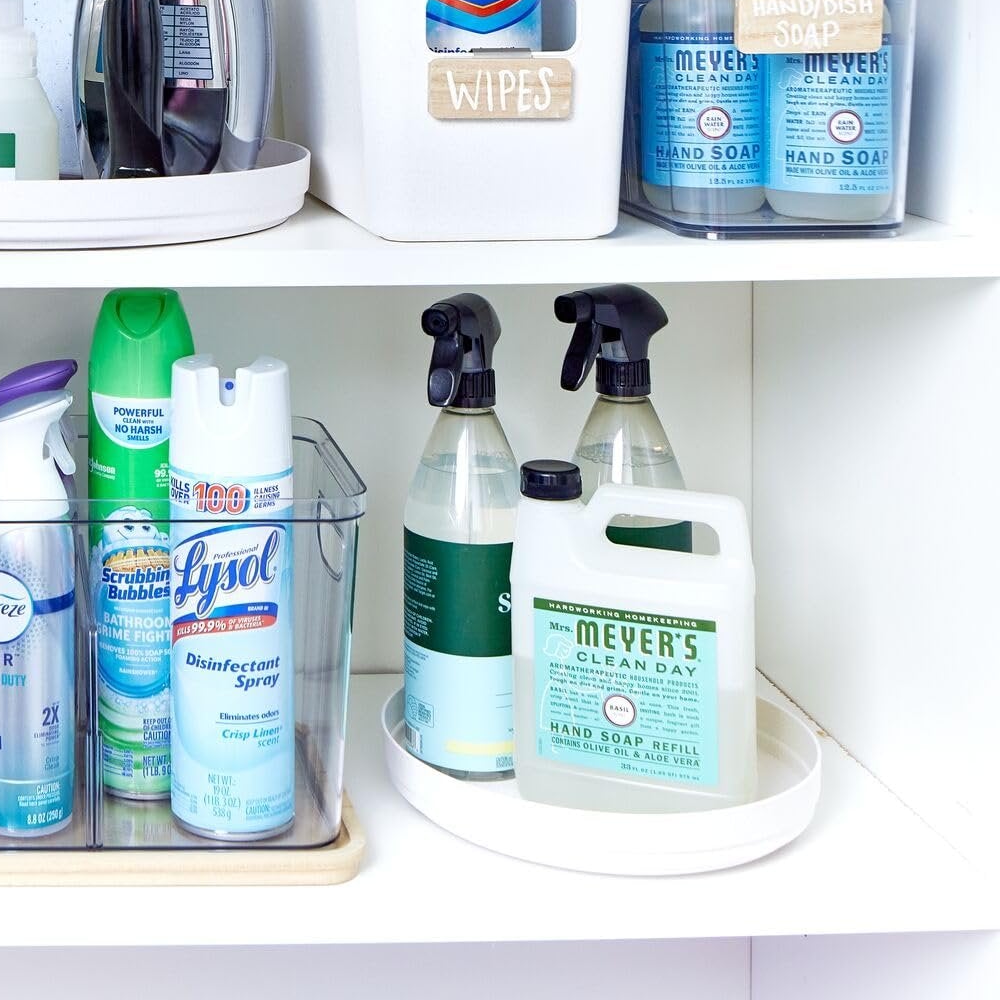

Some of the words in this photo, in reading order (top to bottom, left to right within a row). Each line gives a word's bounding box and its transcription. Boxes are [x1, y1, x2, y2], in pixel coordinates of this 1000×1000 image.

[774, 20, 841, 48] SOAP
[675, 50, 759, 71] MEYERS
[675, 73, 730, 83] CLEAN
[735, 73, 759, 81] DAY
[804, 75, 862, 85] CLEAN
[868, 76, 888, 85] DAY
[446, 67, 554, 112] WIPES
[711, 144, 761, 160] SOAP
[785, 150, 835, 164] HAND
[841, 150, 888, 165] SOAP
[686, 163, 707, 171] OLIVE
[709, 163, 721, 171] OIL
[721, 163, 727, 171] &
[815, 168, 837, 176] OLIVE
[839, 168, 851, 176] OIL
[853, 168, 859, 176] &
[860, 168, 877, 176] ALOE
[113, 407, 164, 417] POWERFUL
[115, 424, 128, 433] NO
[131, 425, 162, 434] HARSH
[193, 482, 250, 515] 100
[254, 485, 279, 494] ILLNESS
[254, 501, 276, 509] GERMS
[213, 544, 259, 560] Professional
[102, 567, 170, 585] Scrubbin
[174, 529, 279, 617] Lysol
[107, 583, 170, 600] Bubbles
[549, 602, 620, 618] HARDWORKING
[625, 613, 697, 628] HOMEKEEPING
[96, 623, 130, 641] GRIME
[134, 629, 170, 642] FIGHT
[177, 625, 191, 636] KILLS
[191, 620, 226, 634] 99.9%
[549, 621, 573, 633] Mrs.
[576, 619, 697, 661] MEYER'S
[186, 652, 280, 672] Disinfectant
[576, 651, 647, 671] CLEAN
[656, 662, 697, 677] DAY
[1, 673, 26, 686] DUTY
[234, 673, 280, 691] Spray
[549, 662, 627, 679] AROMATHERAPEUTIC
[630, 674, 663, 684] HOUSEHOLD
[667, 680, 699, 689] PRODUCTS
[42, 705, 59, 727] 2X
[219, 712, 260, 721] Eliminates
[261, 710, 279, 719] odors
[609, 705, 629, 713] BASIL
[222, 728, 250, 741] Crisp
[253, 726, 280, 738] Linen
[258, 736, 280, 747] scent
[550, 722, 592, 739] HAND
[601, 731, 644, 747] SOAP
[653, 740, 699, 756] REFILL
[551, 736, 581, 748] CONTAINS
[583, 742, 610, 754] OLIVE
[614, 748, 629, 757] OIL
[633, 751, 641, 759] &
[644, 752, 670, 763] ALOE
[673, 757, 700, 767] VERA
[143, 755, 155, 765] NET
[620, 763, 631, 771] 33
[208, 773, 220, 784] NET
[213, 786, 220, 795] 19
[27, 814, 37, 824] 8.8
[37, 812, 46, 823] OZ
[212, 807, 225, 817] 538
